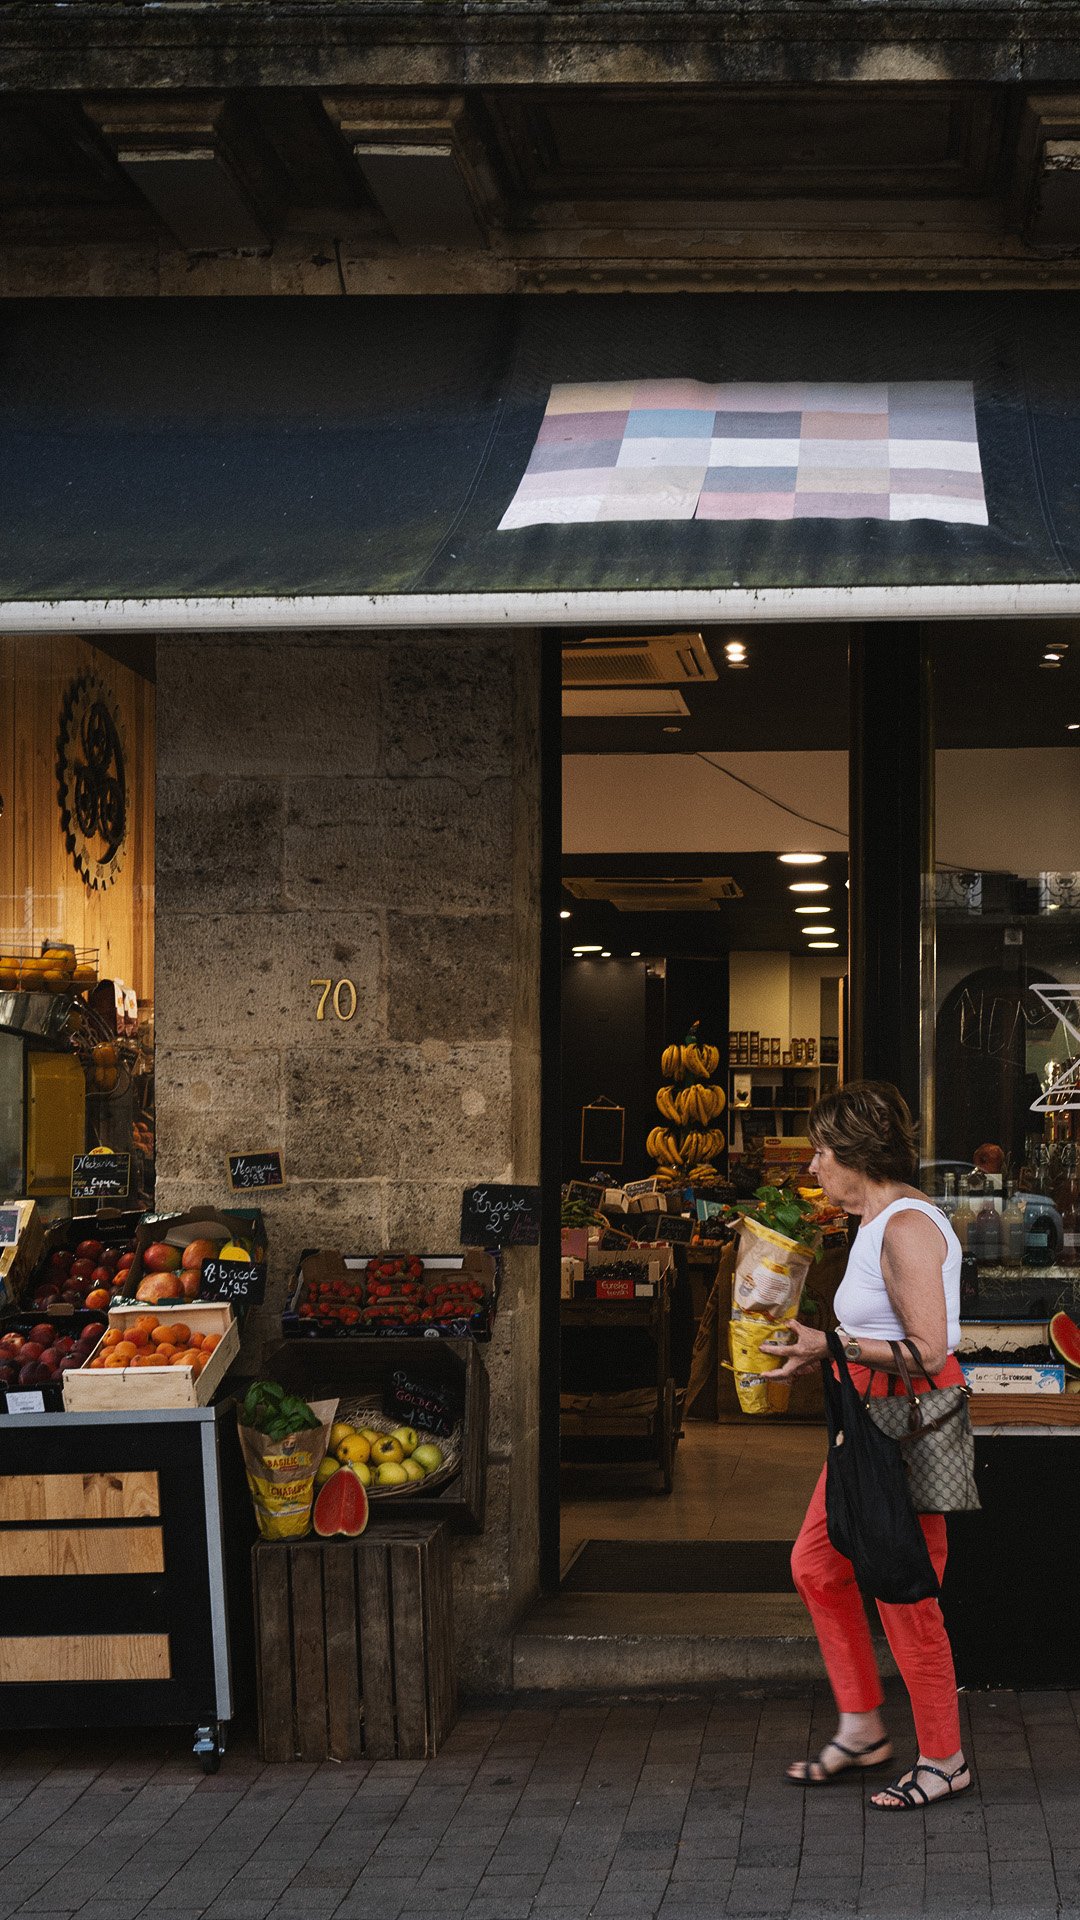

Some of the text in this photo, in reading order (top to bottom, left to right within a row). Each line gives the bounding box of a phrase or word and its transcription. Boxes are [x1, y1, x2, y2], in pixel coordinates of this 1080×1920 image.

[310, 979, 357, 1020] 70
[470, 1190, 532, 1212] Fraise
[204, 1263, 258, 1283] Abricot
[267, 1456, 298, 1469] BASILIC
